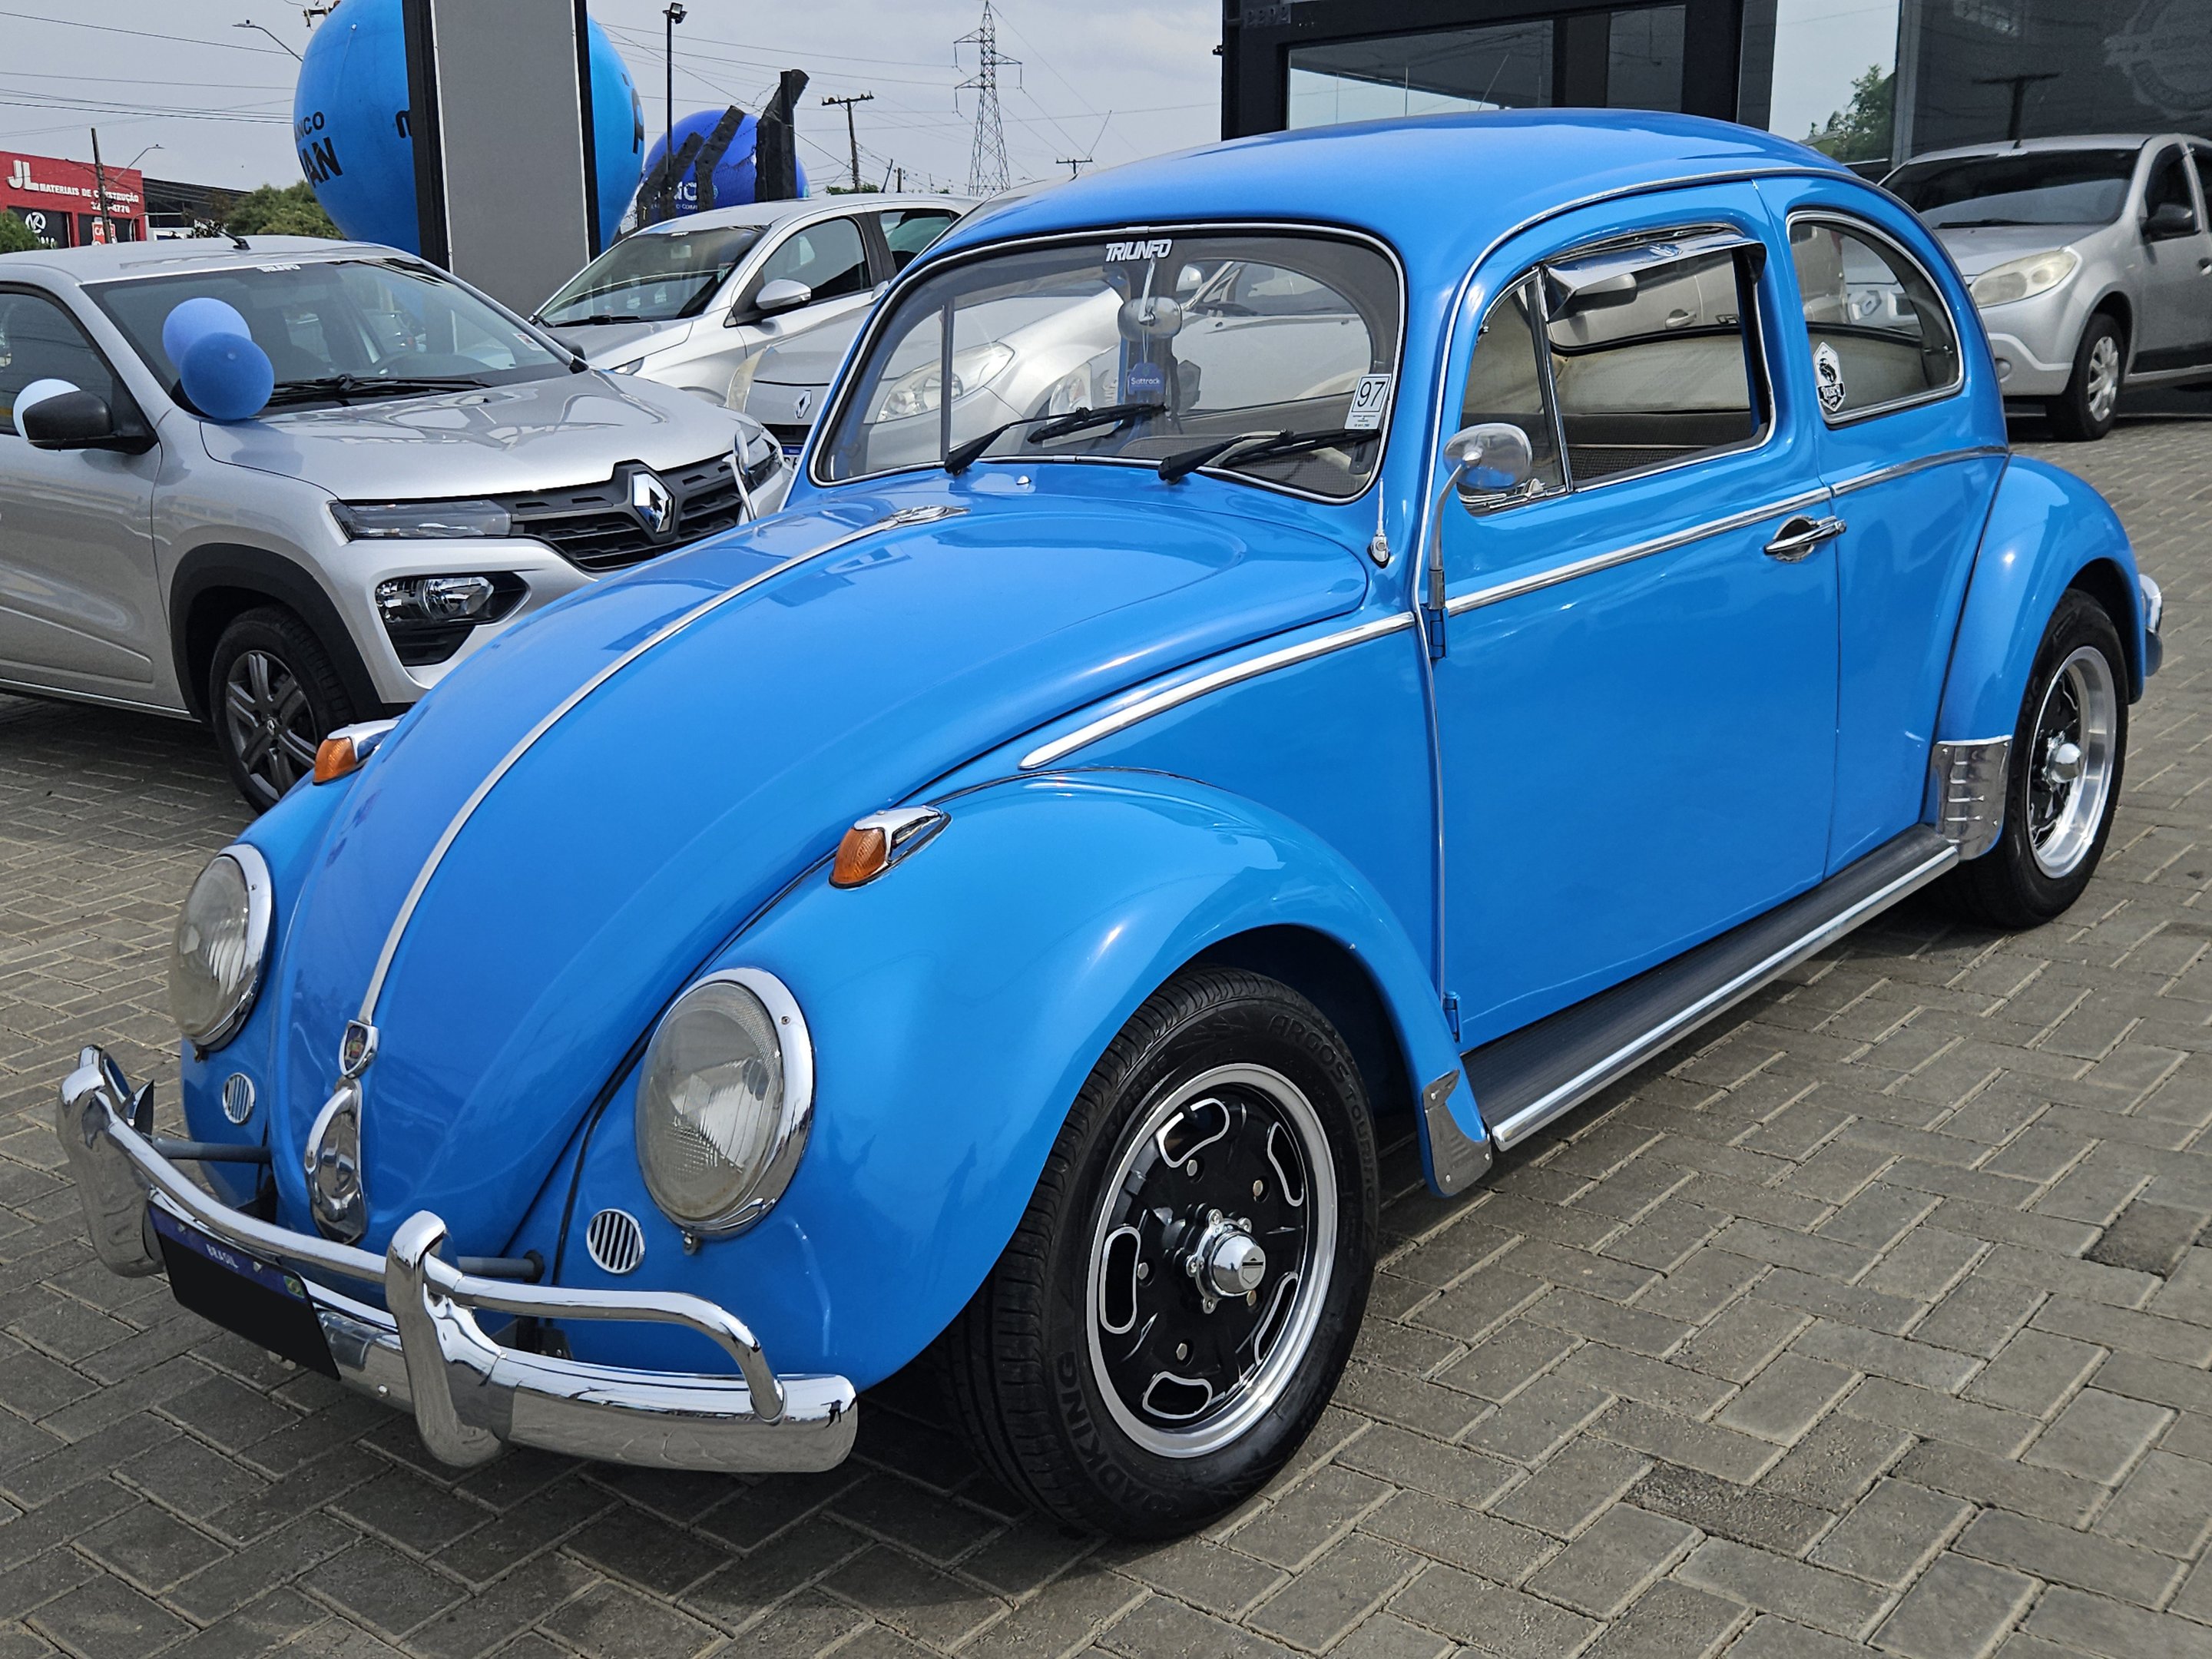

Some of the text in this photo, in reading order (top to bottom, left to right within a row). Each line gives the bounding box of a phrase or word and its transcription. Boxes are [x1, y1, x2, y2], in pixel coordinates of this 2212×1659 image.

[299, 137, 343, 188] AN
[7, 160, 38, 191] JL
[39, 184, 79, 197] MATERIAIS
[81, 188, 92, 198] DE
[1104, 239, 1173, 263] TRIUNFO
[1356, 381, 1386, 407] 97
[1267, 1012, 1351, 1083] ARGOS
[206, 1243, 239, 1269] BRASIL
